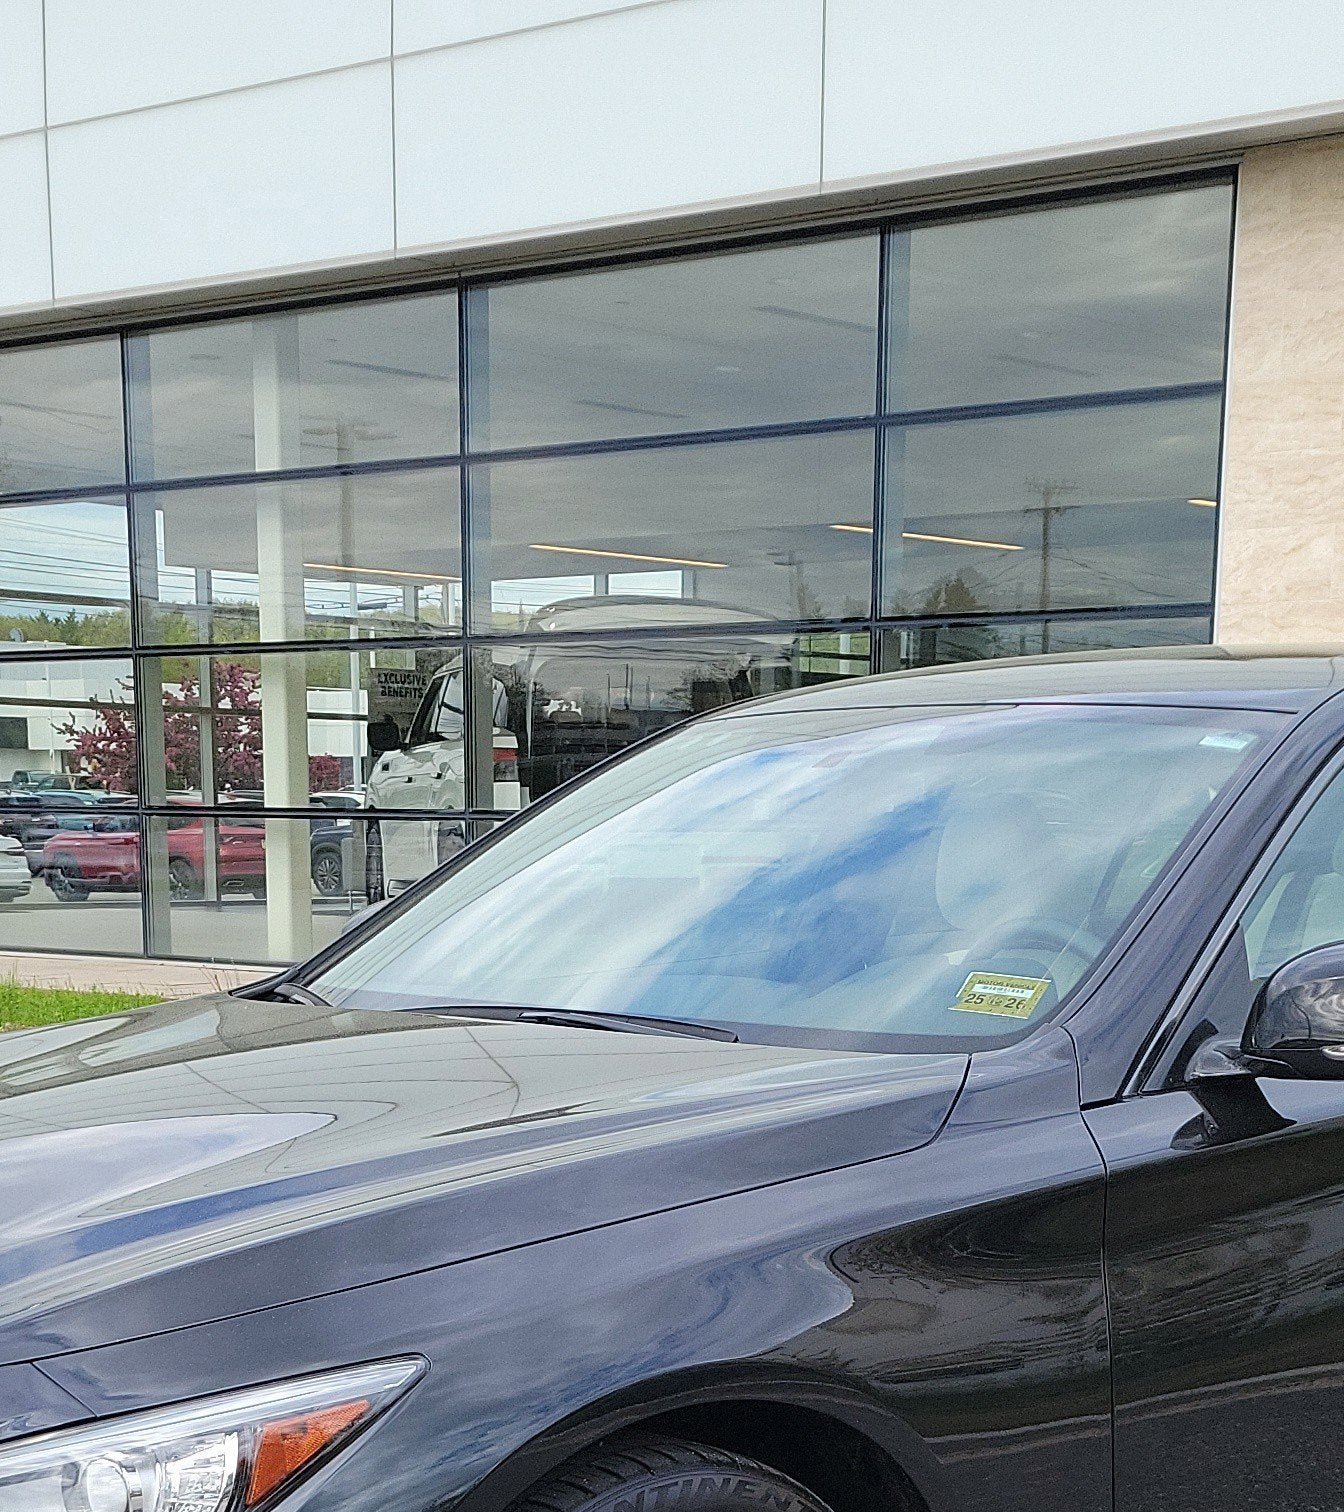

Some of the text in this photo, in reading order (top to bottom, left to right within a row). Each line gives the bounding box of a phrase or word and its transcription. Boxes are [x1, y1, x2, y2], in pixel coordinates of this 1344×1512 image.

[377, 672, 427, 686] EXCLUSIVE
[380, 685, 424, 698] BENEFITS
[964, 993, 986, 1005] 25
[1003, 997, 1027, 1009] 26
